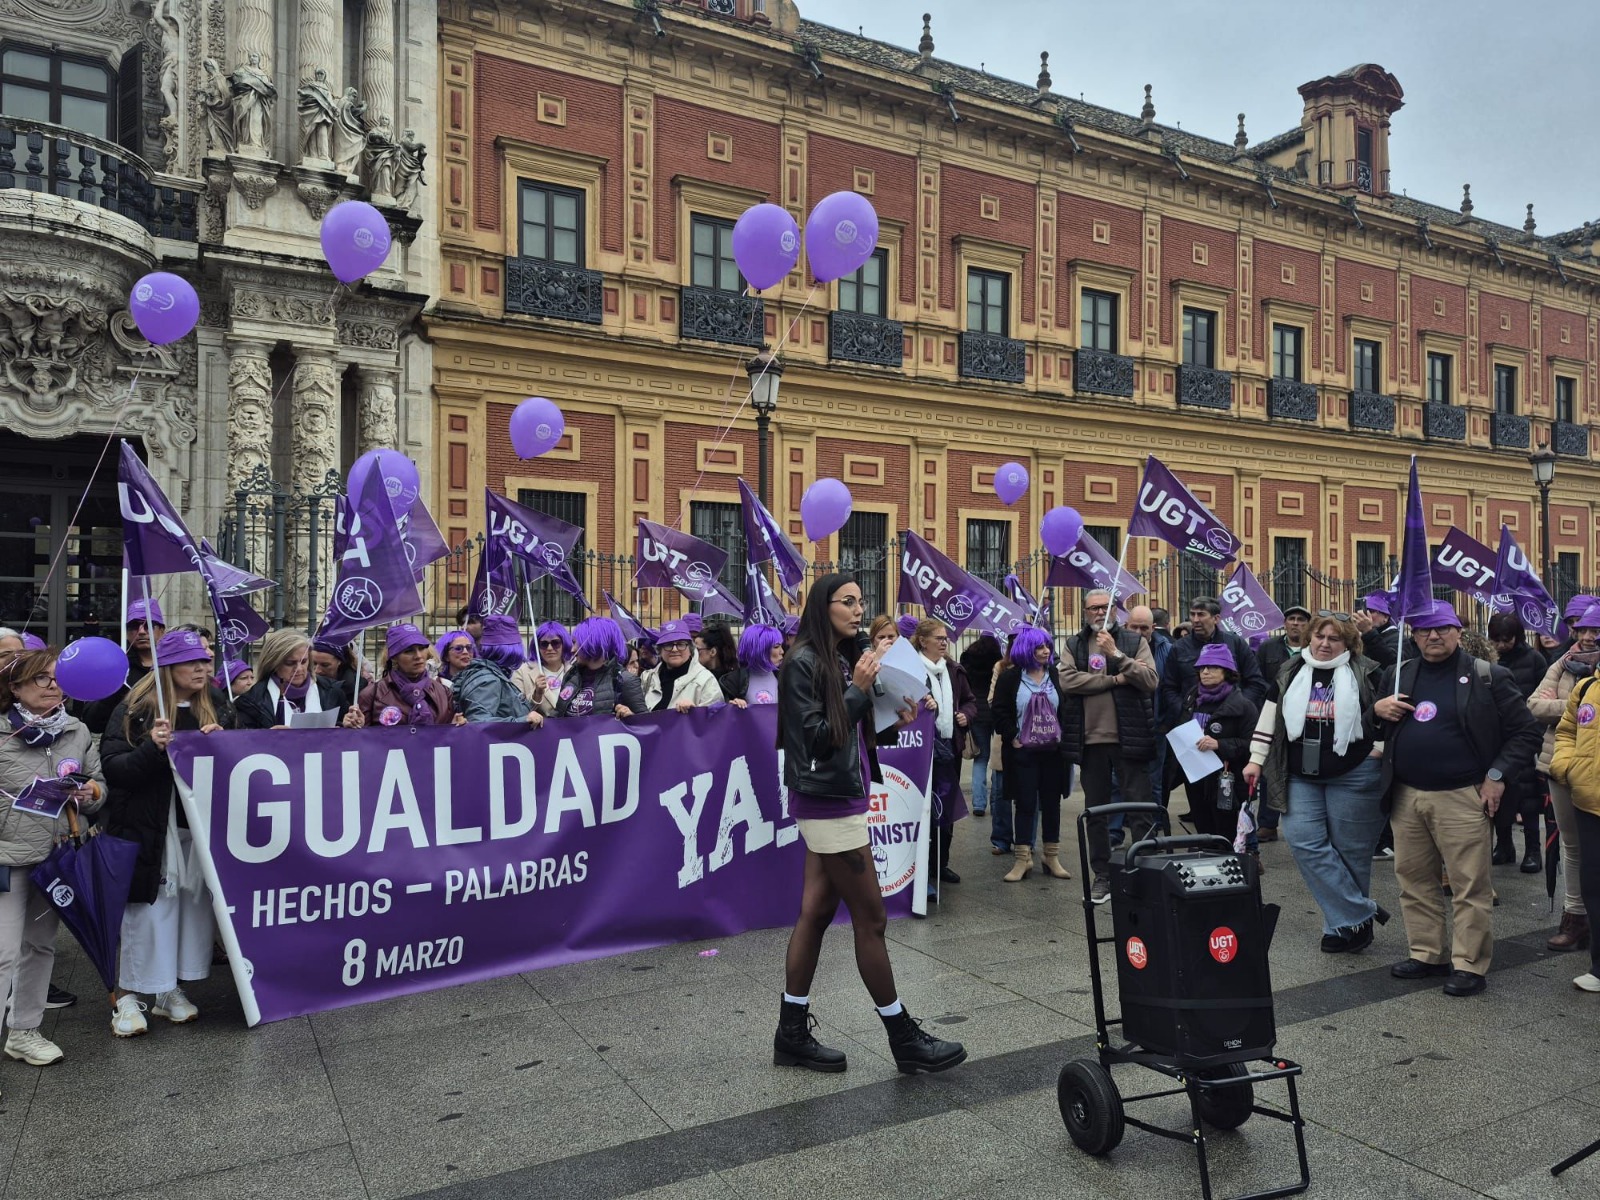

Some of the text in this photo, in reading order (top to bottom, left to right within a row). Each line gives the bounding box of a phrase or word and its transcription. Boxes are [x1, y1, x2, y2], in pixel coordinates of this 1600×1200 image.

[356, 230, 372, 241] UGT
[839, 222, 856, 236] UGT
[386, 479, 402, 490] UGT
[1139, 482, 1206, 535] UGT
[902, 551, 953, 599] UGT
[1437, 544, 1496, 587] UGT
[1223, 580, 1255, 612] GT
[885, 771, 911, 790] UNIDAS
[192, 733, 642, 863] IGUALDAD
[868, 793, 889, 812] GT
[867, 813, 887, 824] evilla
[894, 861, 916, 889] IGUALDA
[252, 878, 392, 927] HECHOS
[446, 851, 589, 905] PALABRAS
[1130, 941, 1144, 955] UGT
[1210, 934, 1234, 949] UGT
[342, 935, 464, 986] 8 MARZO
